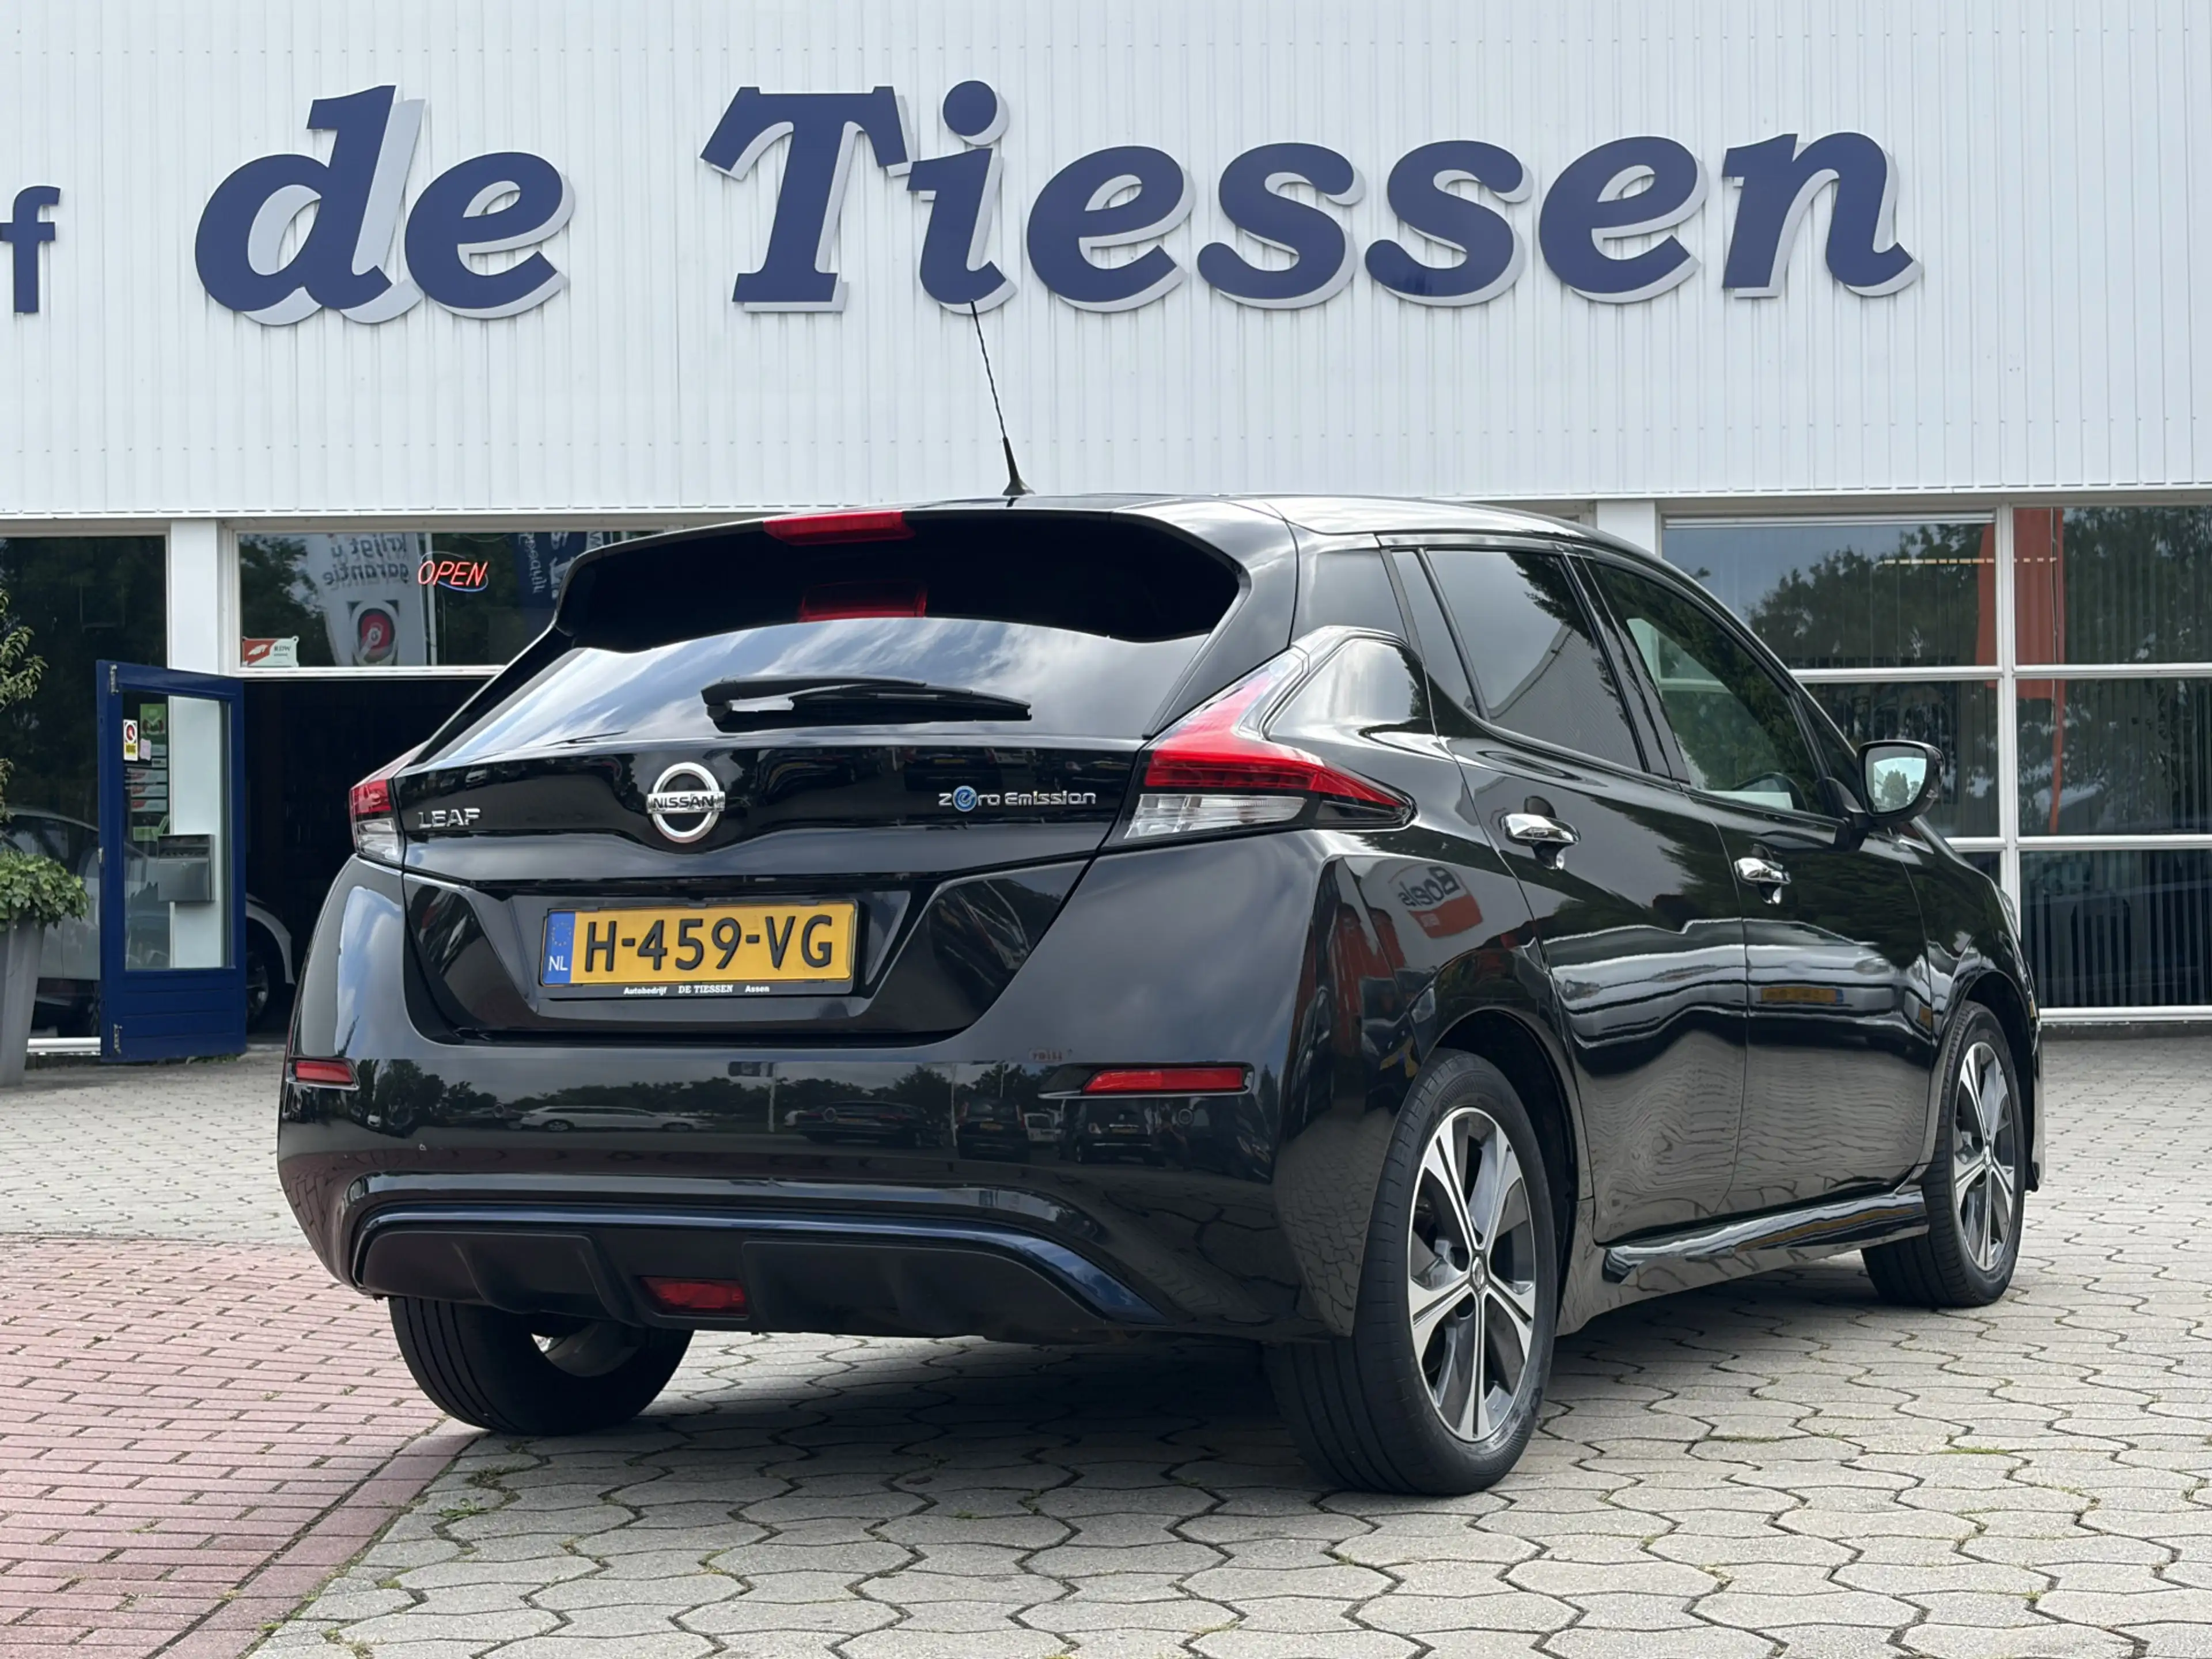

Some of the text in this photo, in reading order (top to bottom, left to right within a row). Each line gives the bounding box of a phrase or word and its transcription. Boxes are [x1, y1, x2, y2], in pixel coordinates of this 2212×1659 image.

[194, 85, 575, 325] de
[699, 79, 1923, 314] Tiessen
[418, 560, 488, 587] OPEN
[653, 794, 715, 809] NISSAN
[418, 808, 481, 828] LEAF
[548, 915, 832, 972] NL H-459-VG
[623, 984, 770, 995] Autobedrijf DE TIESSEN Assen
